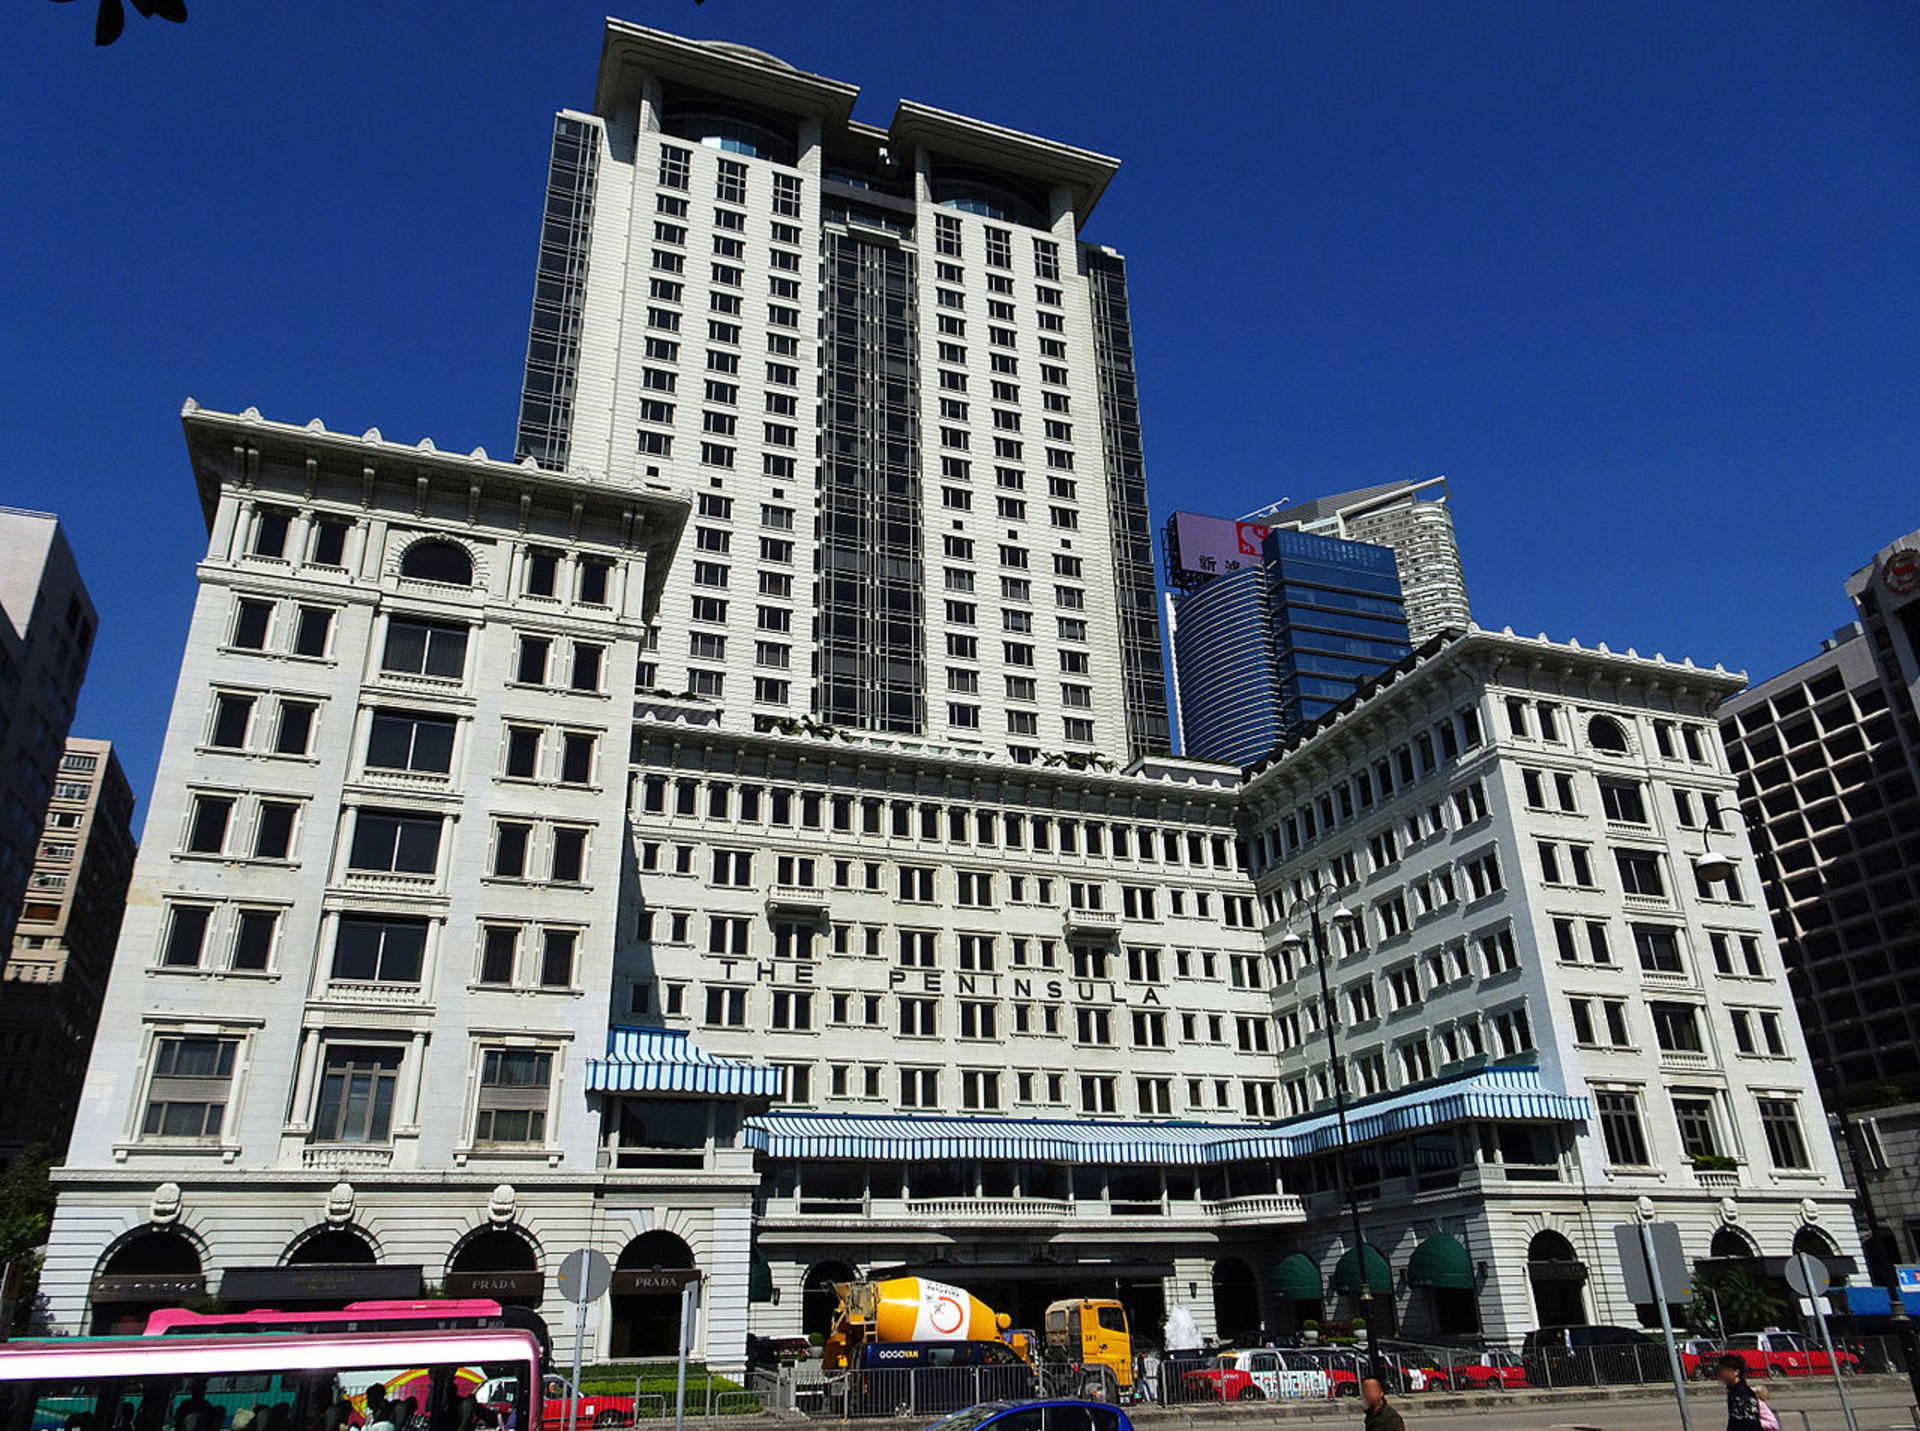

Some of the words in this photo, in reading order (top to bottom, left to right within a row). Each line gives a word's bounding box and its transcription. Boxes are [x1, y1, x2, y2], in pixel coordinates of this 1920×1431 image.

[720, 960, 813, 983] THE
[889, 970, 1160, 1005] PENINSULA
[472, 1280, 516, 1289] PRADA
[635, 1278, 677, 1287] PRADA
[879, 1350, 919, 1359] GOGOVAN
